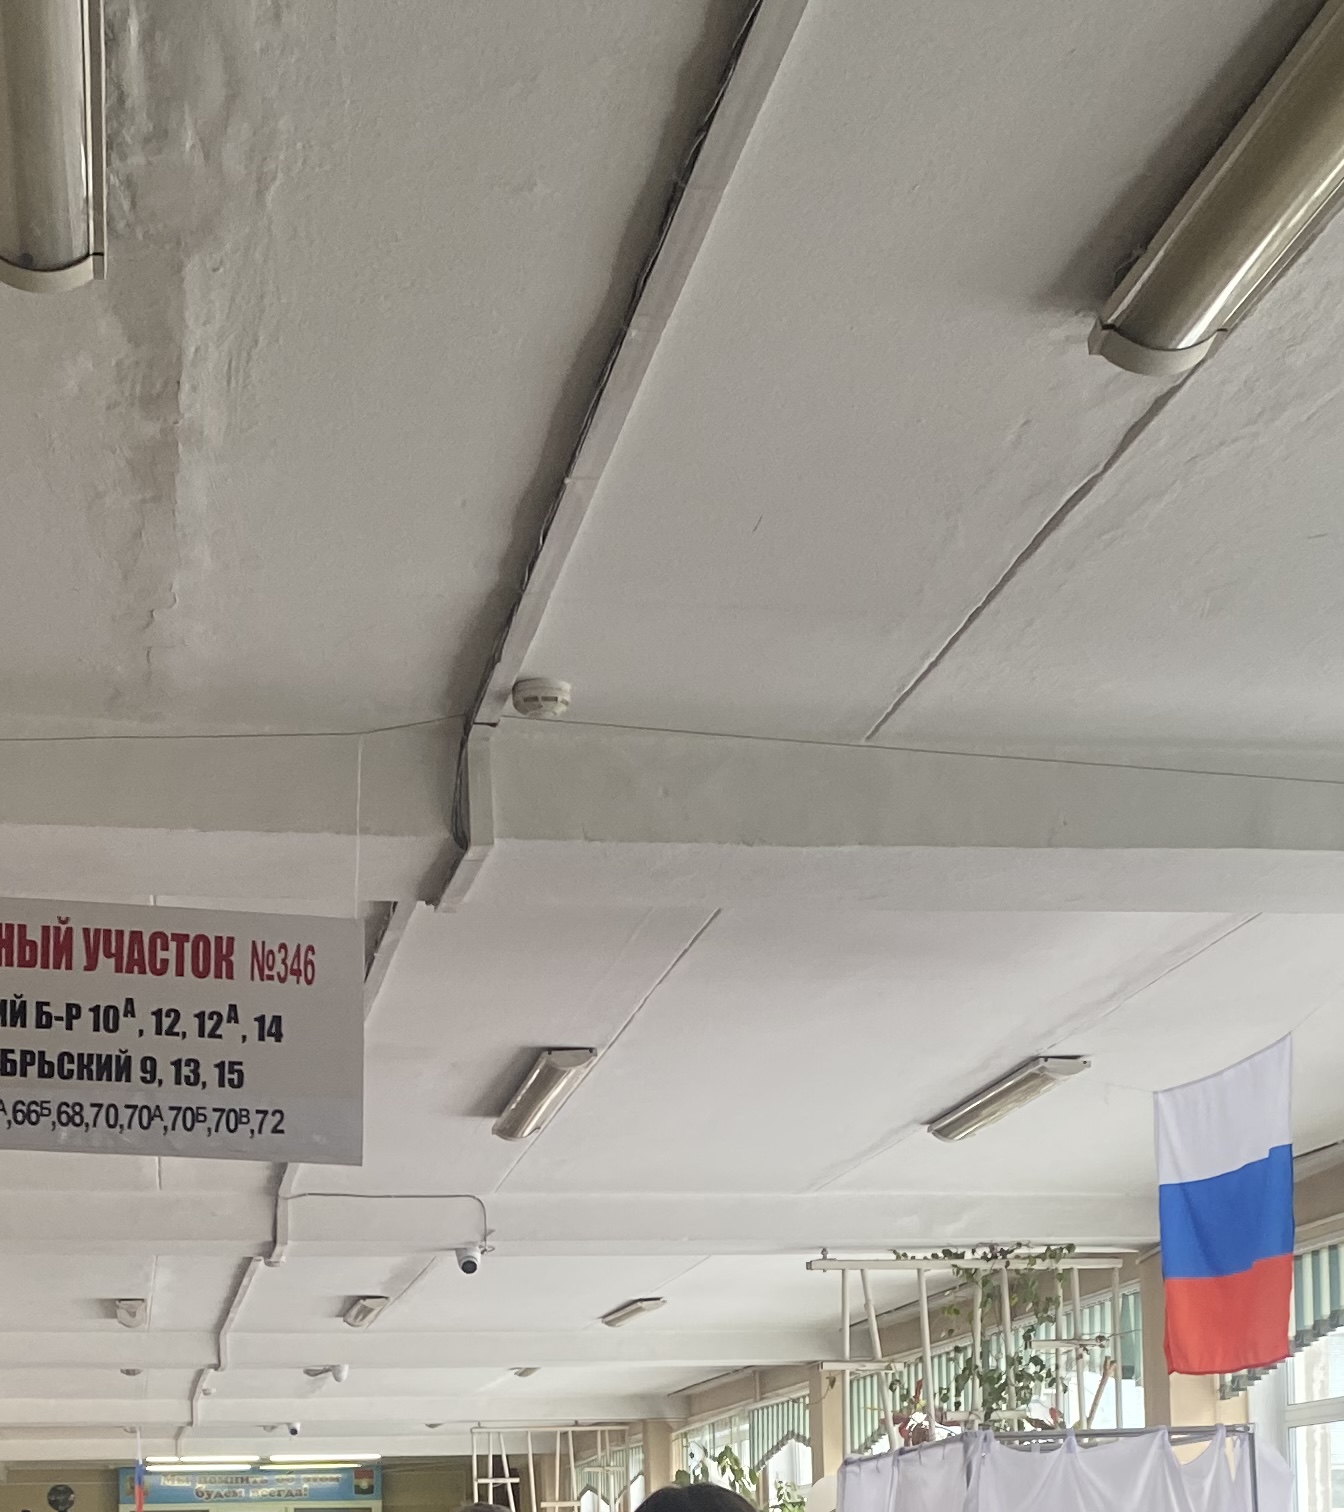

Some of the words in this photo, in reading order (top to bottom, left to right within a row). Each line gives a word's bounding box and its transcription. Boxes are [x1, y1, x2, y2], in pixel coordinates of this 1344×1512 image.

[82, 927, 235, 980] УЧАСТОК
[250, 938, 316, 986] №346
[35, 1000, 82, 1032] Б-Р
[151, 1008, 187, 1040] 12,
[253, 1013, 283, 1043] 14
[139, 1055, 164, 1088] 9,
[170, 1058, 207, 1090] 13,
[213, 1060, 245, 1089] 15
